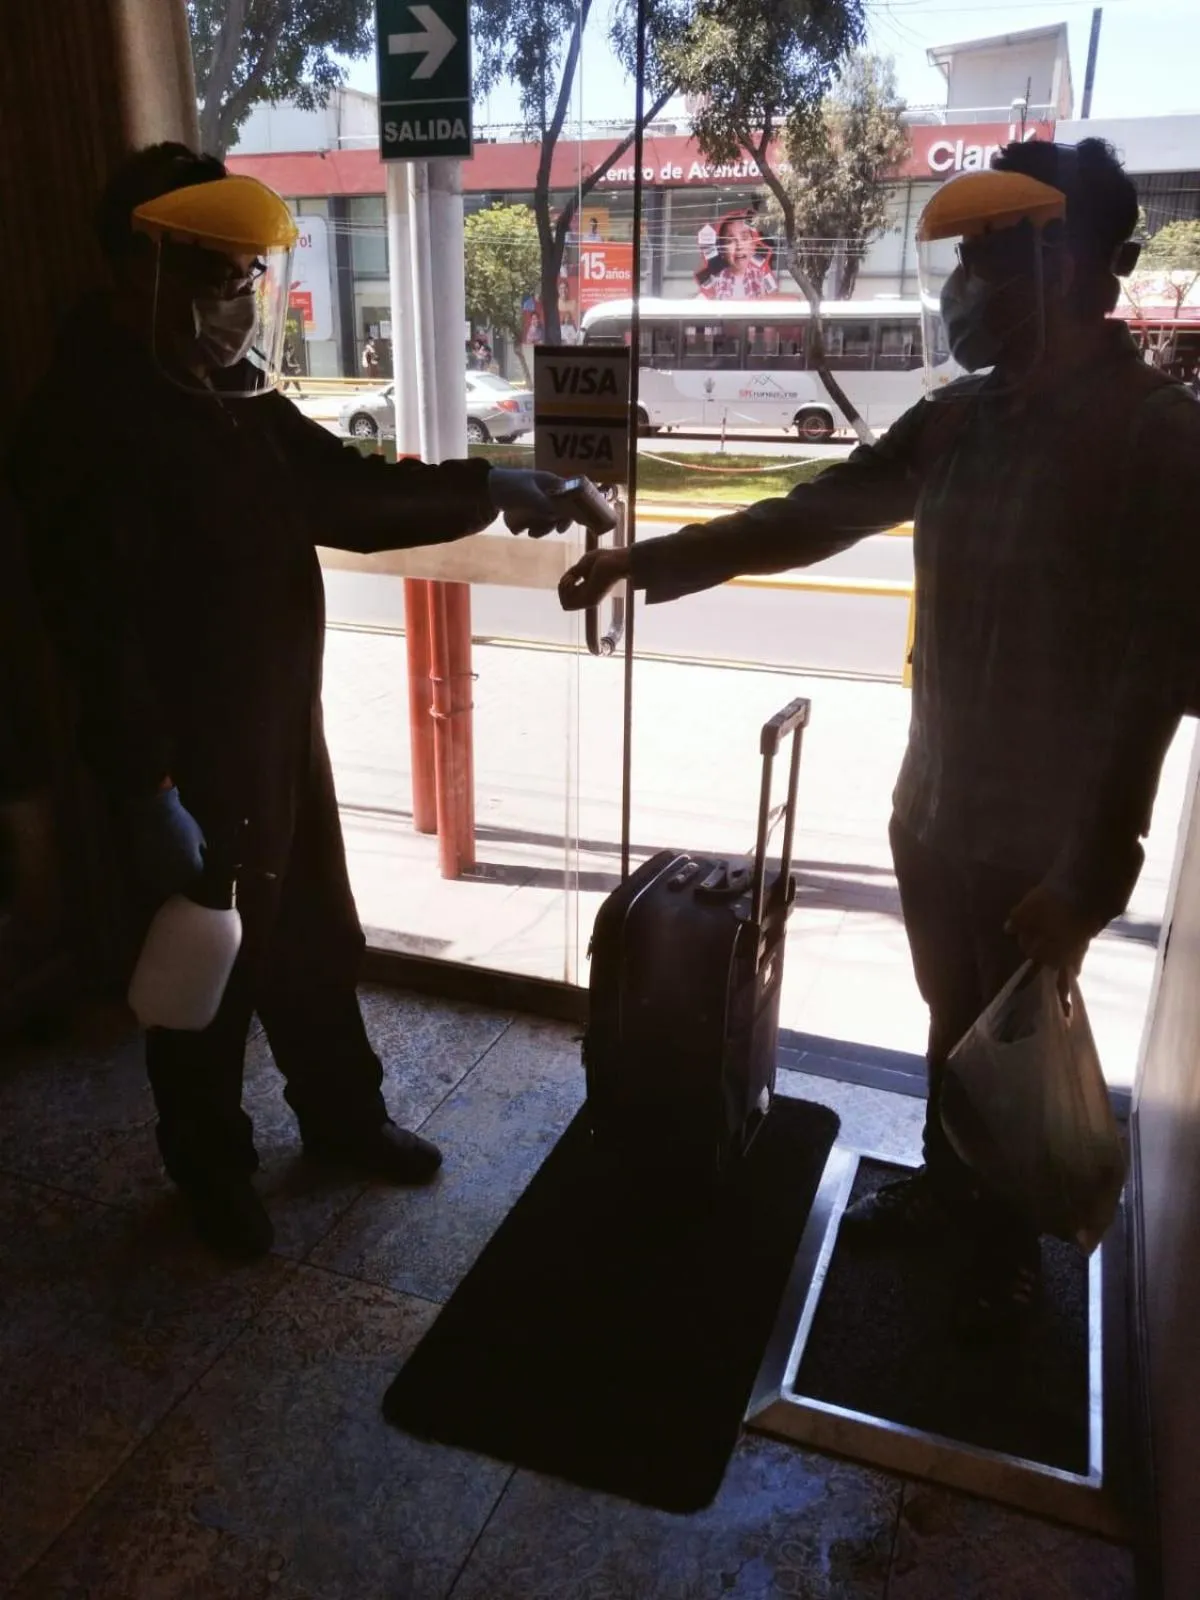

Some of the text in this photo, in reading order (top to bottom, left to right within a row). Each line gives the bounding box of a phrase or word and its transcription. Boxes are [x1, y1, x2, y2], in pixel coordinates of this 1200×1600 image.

[384, 118, 467, 143] SALIDA
[927, 140, 1005, 171] Clar
[660, 162, 684, 181] de
[581, 252, 631, 281] 15 años
[545, 366, 618, 396] VISA
[547, 432, 614, 462] VISA
